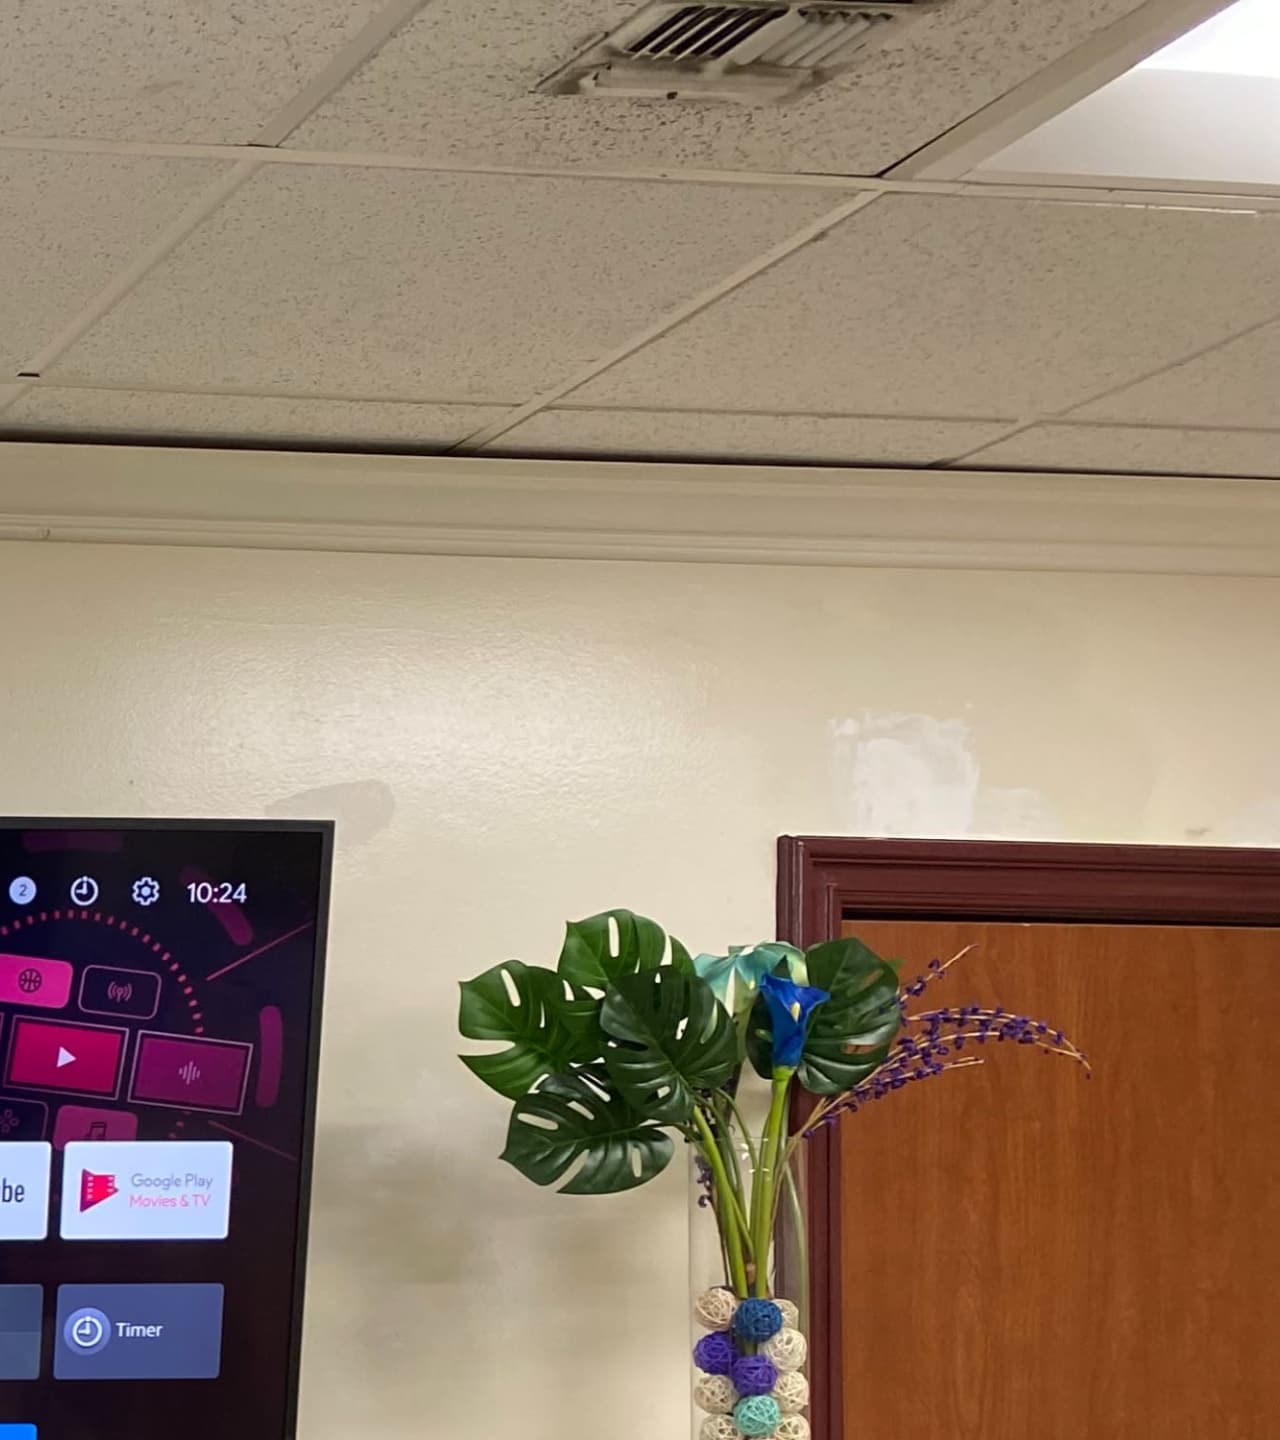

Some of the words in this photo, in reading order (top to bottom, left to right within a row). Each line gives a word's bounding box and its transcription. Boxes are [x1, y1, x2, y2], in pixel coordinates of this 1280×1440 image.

[19, 884, 27, 896] 2
[187, 882, 247, 903] 10:24
[131, 1173, 182, 1190] Google
[186, 1173, 213, 1190] Play
[129, 1195, 175, 1207] Movies
[176, 1194, 190, 1208] &
[192, 1194, 211, 1206] TV
[116, 1323, 163, 1337] Timer
